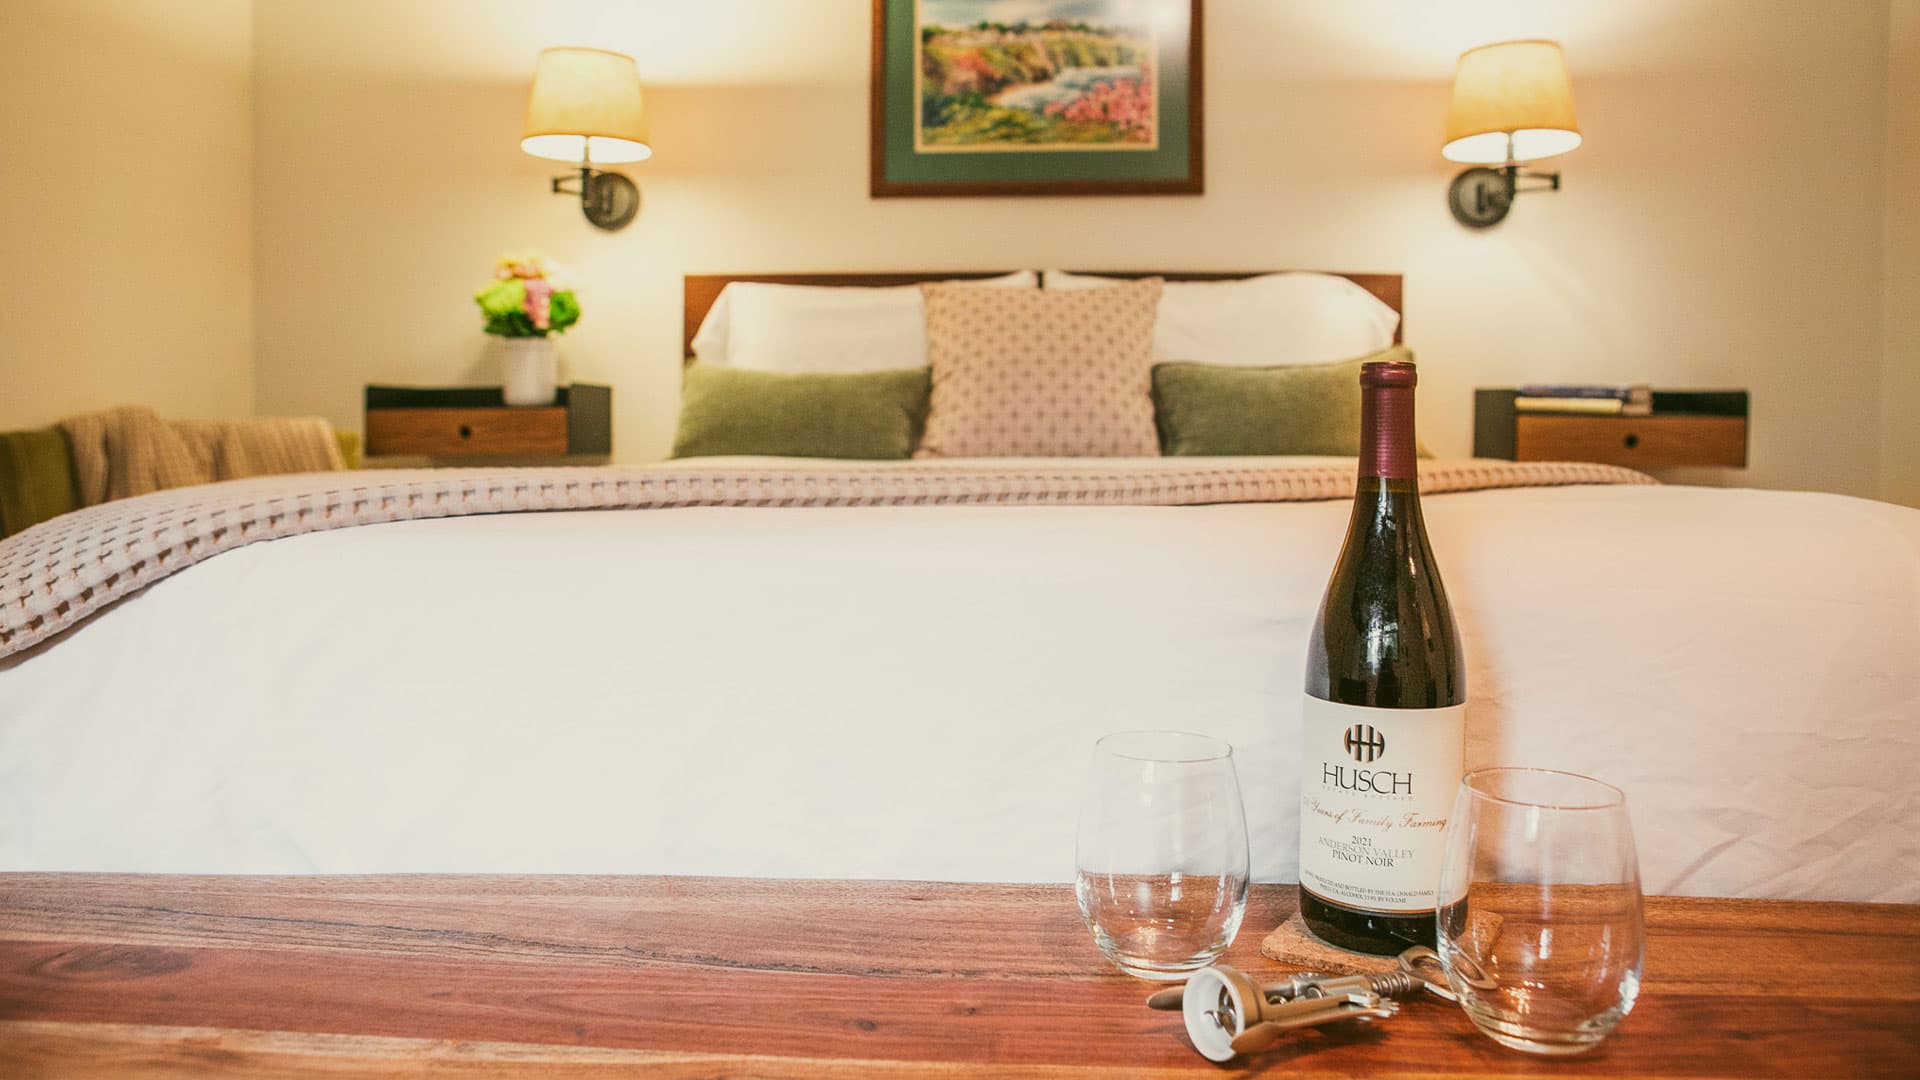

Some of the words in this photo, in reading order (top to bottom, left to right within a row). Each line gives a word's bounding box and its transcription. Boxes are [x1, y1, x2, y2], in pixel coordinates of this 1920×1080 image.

[1323, 762, 1412, 794] HUSCH
[1333, 809, 1347, 824] of
[1350, 808, 1392, 832] Family
[1399, 812, 1447, 832] Farming
[1318, 836, 1370, 855] ANDERSON
[1373, 847, 1415, 859] VALLEY
[1352, 835, 1371, 847] 2021
[1332, 849, 1362, 864] PINOT
[1366, 856, 1394, 867] NOIR
